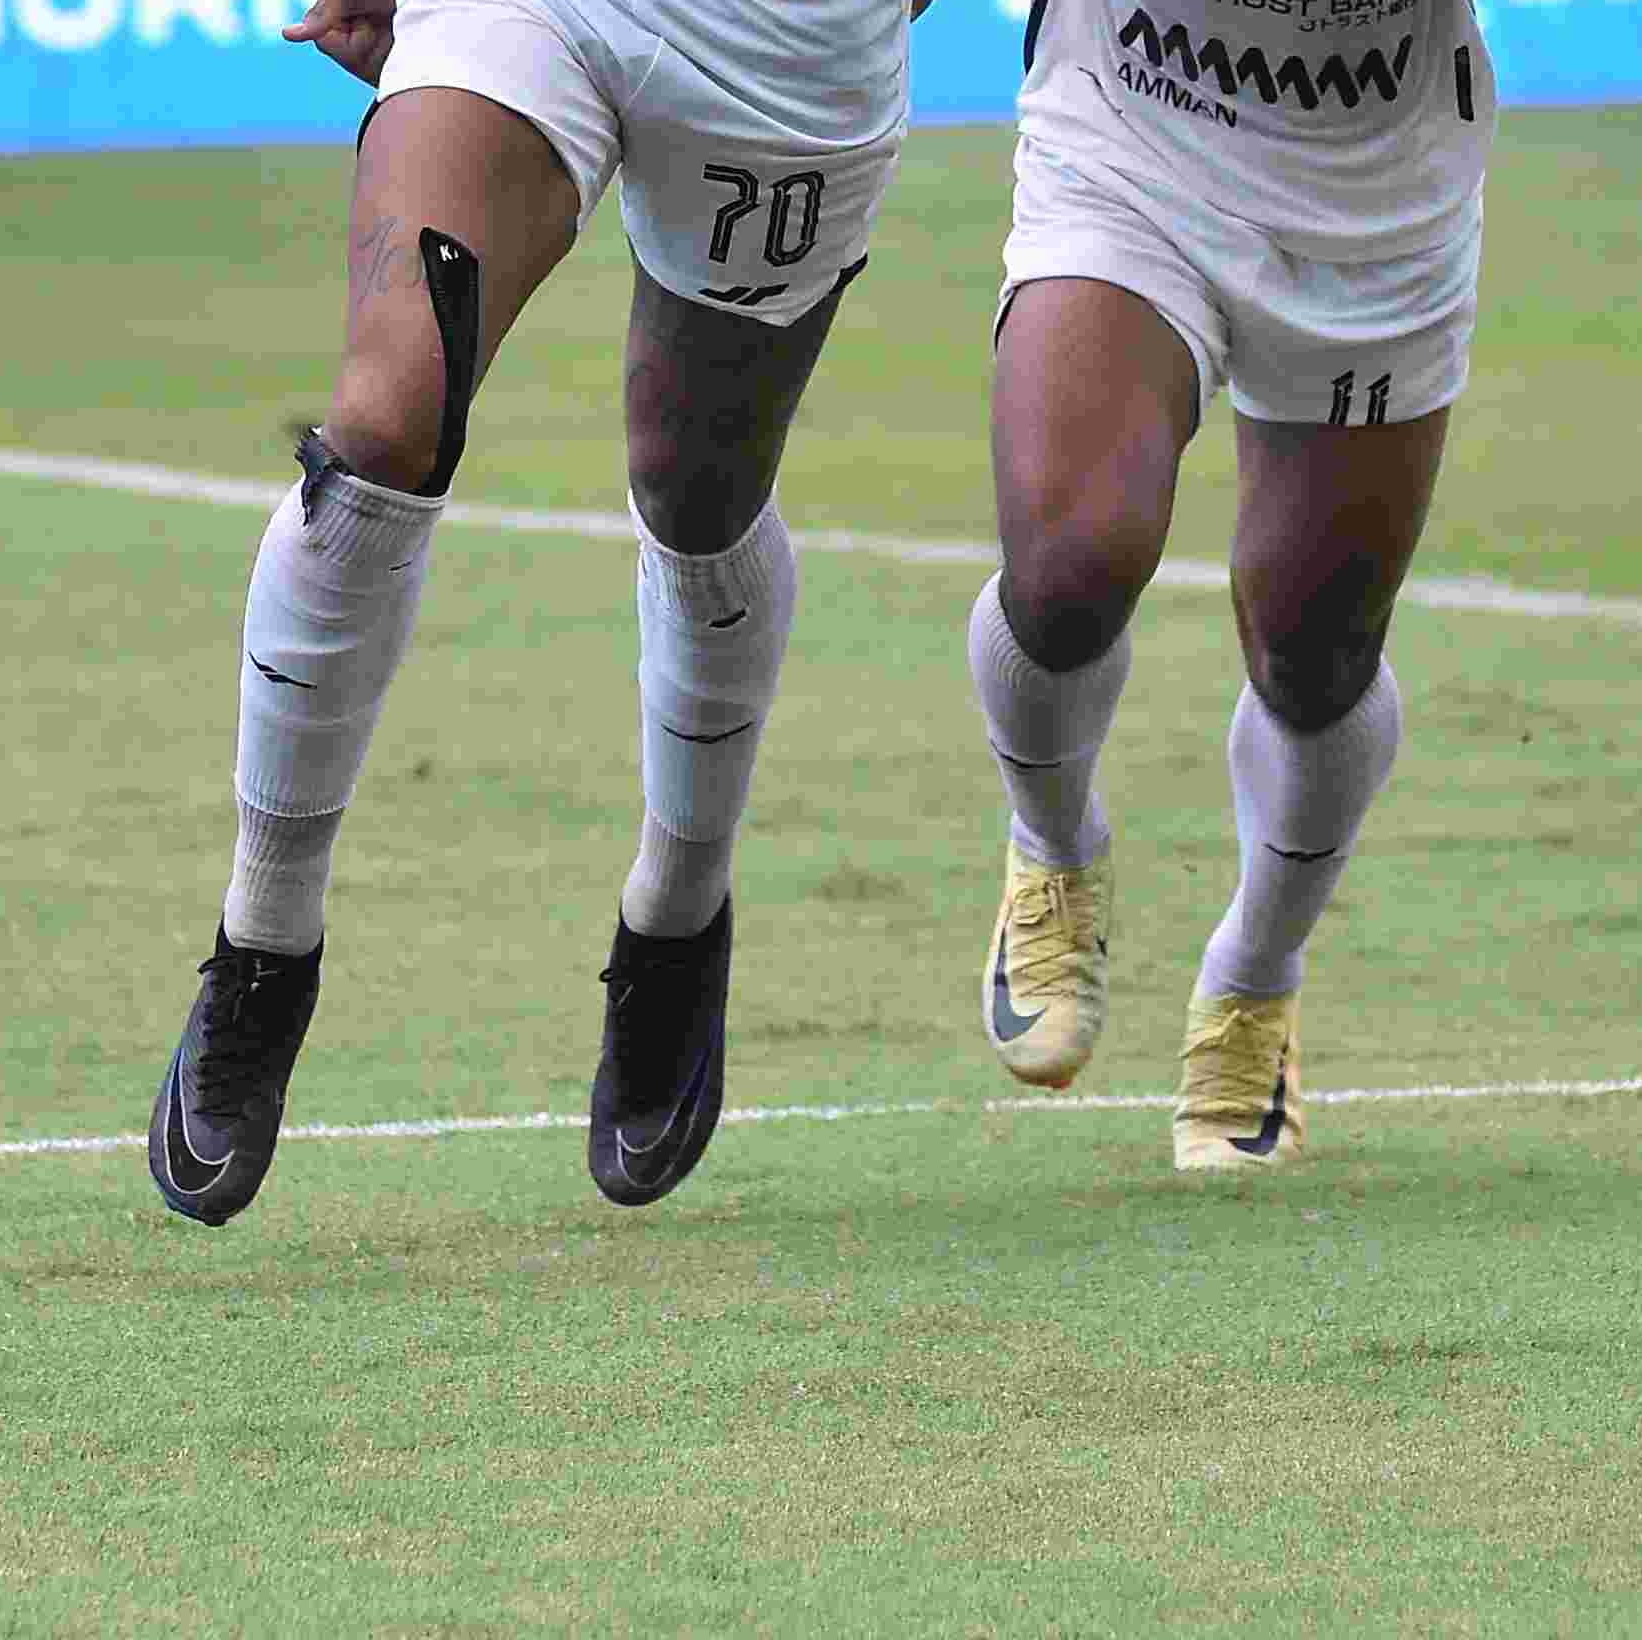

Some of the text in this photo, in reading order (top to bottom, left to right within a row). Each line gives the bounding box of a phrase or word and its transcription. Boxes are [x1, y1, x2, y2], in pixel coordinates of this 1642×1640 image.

[1117, 61, 1238, 128] AMMAN
[702, 163, 826, 268] 70
[1328, 368, 1392, 425] 11
